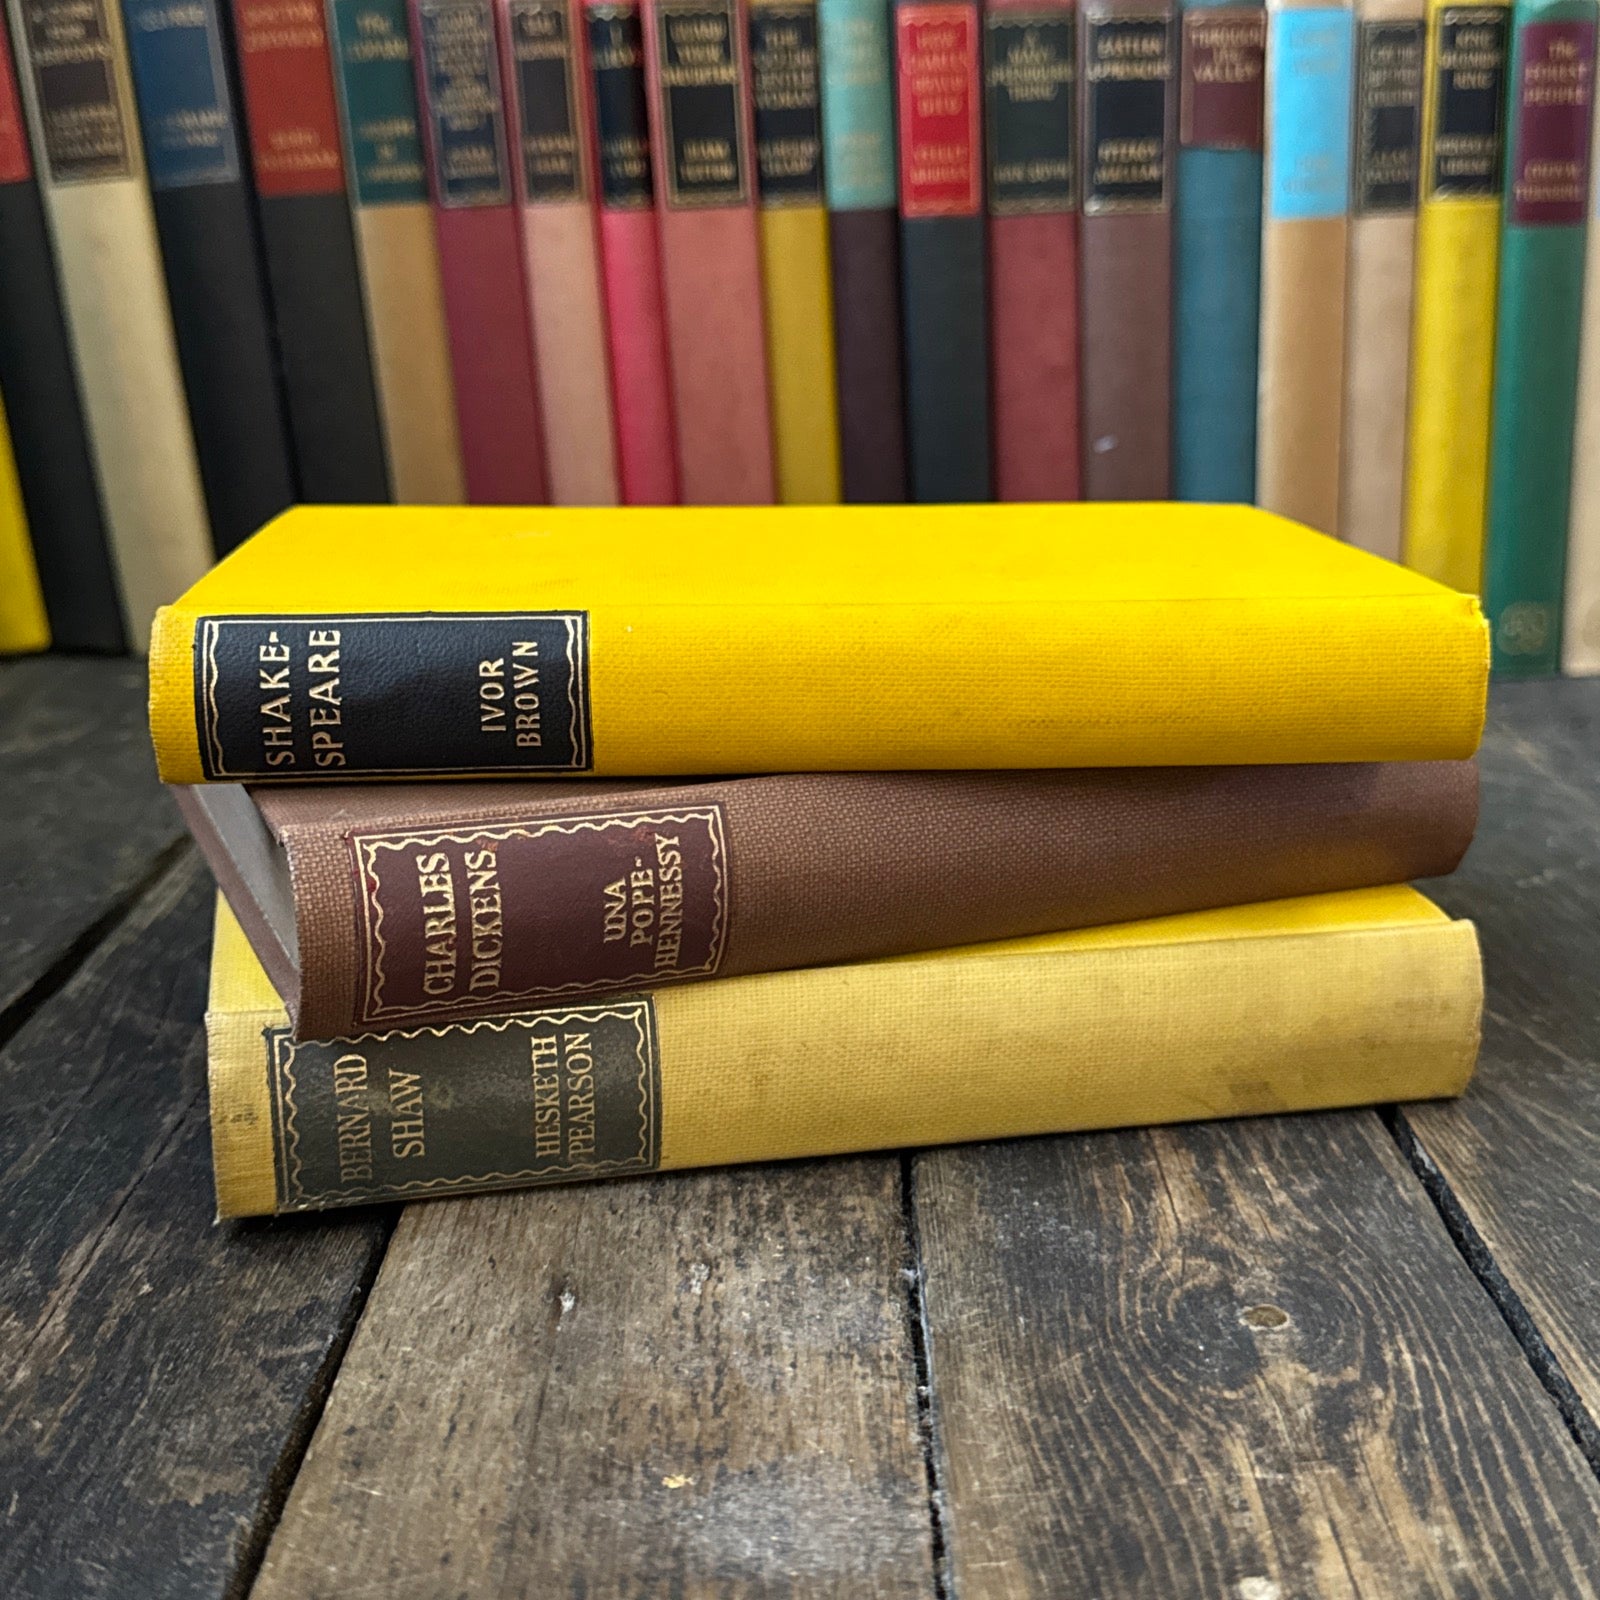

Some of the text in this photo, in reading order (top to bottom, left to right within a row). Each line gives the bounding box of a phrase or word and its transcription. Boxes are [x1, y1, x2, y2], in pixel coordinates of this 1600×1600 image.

[259, 631, 295, 767] SHAKE-
[308, 628, 347, 767] SPEARE
[479, 657, 507, 732] IVOR
[512, 641, 543, 748] BROWN
[416, 852, 458, 996] CHARLES
[465, 849, 502, 992] DICKENS
[603, 877, 628, 944] UNA
[630, 856, 655, 948] POPE-
[654, 833, 684, 970] HENNESSY
[333, 1053, 373, 1184] BERNARD
[388, 1068, 426, 1159] SHAW
[531, 1034, 561, 1159] HESKETH
[564, 1031, 596, 1162] PEARSON
